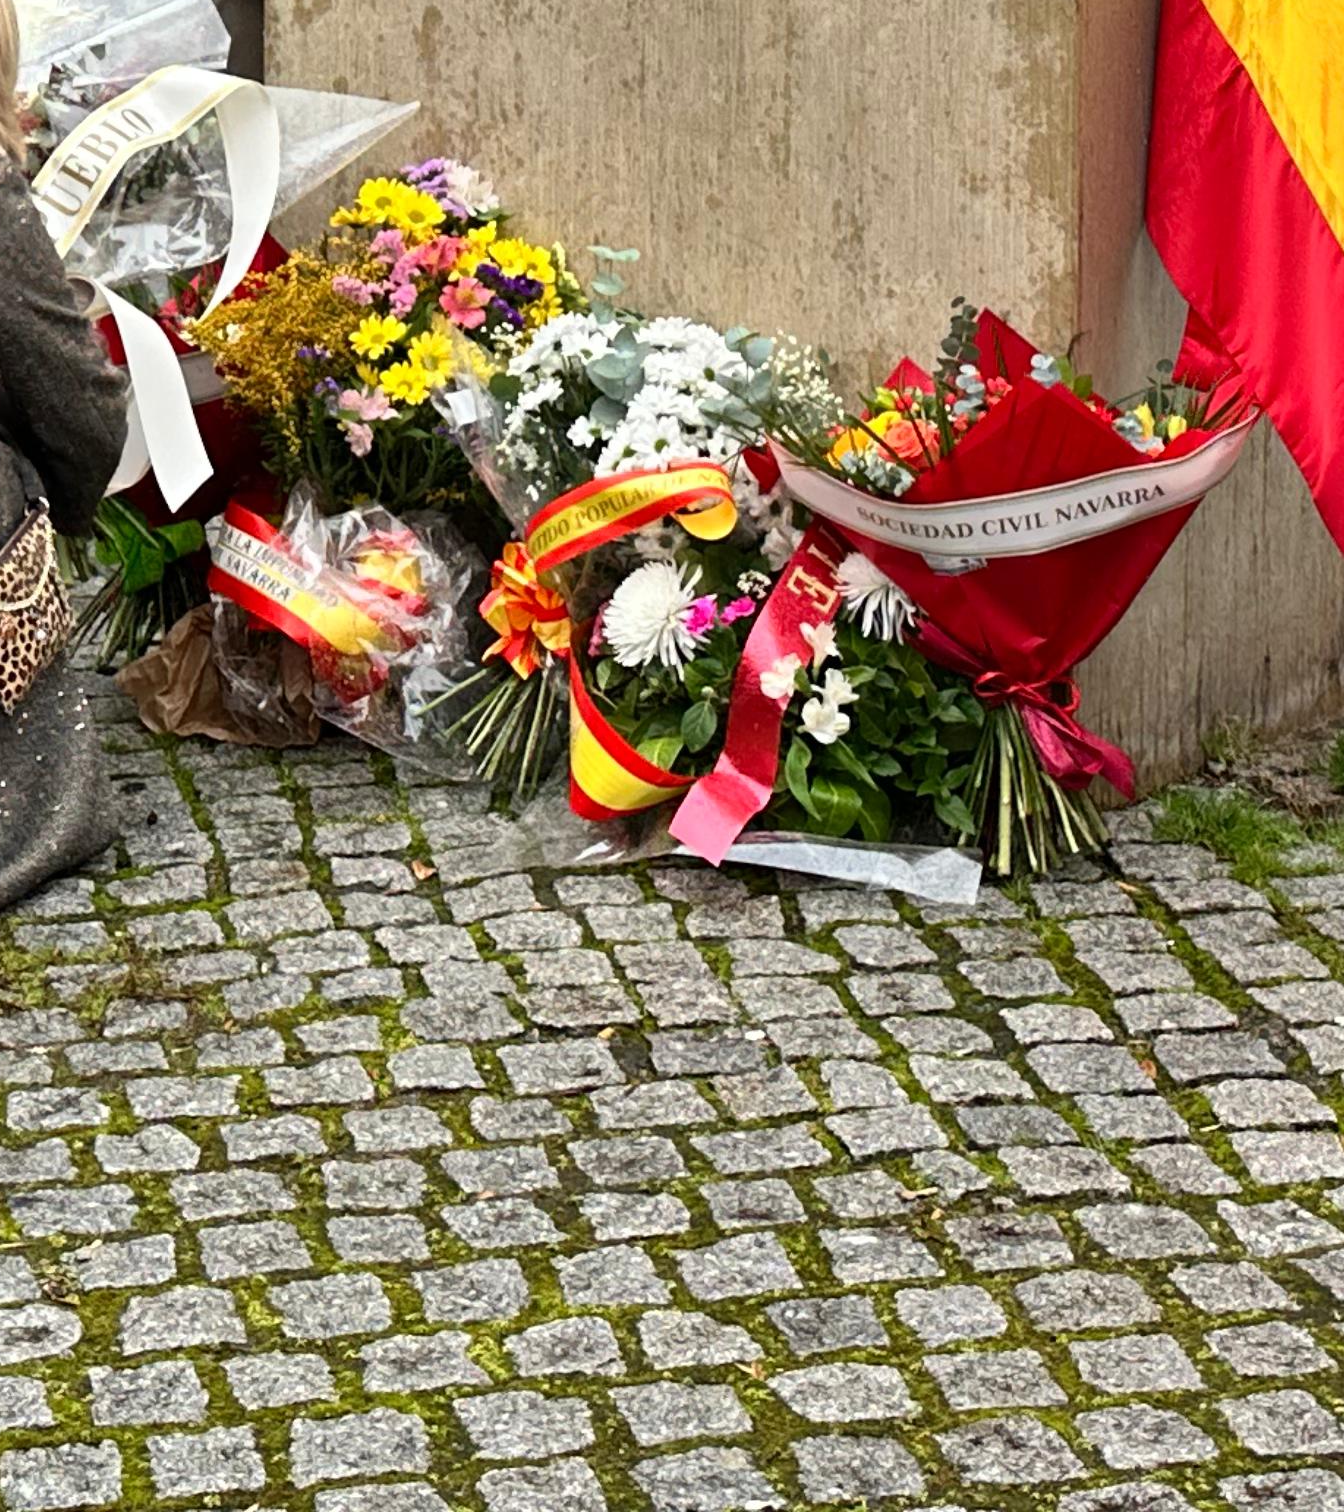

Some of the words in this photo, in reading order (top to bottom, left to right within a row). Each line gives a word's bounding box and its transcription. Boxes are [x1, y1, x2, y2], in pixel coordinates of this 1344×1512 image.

[574, 483, 656, 530] POPULAR
[856, 506, 974, 539] SOCIEDAD
[981, 511, 1049, 538] CIVIL
[1055, 484, 1167, 526] NAVARRA
